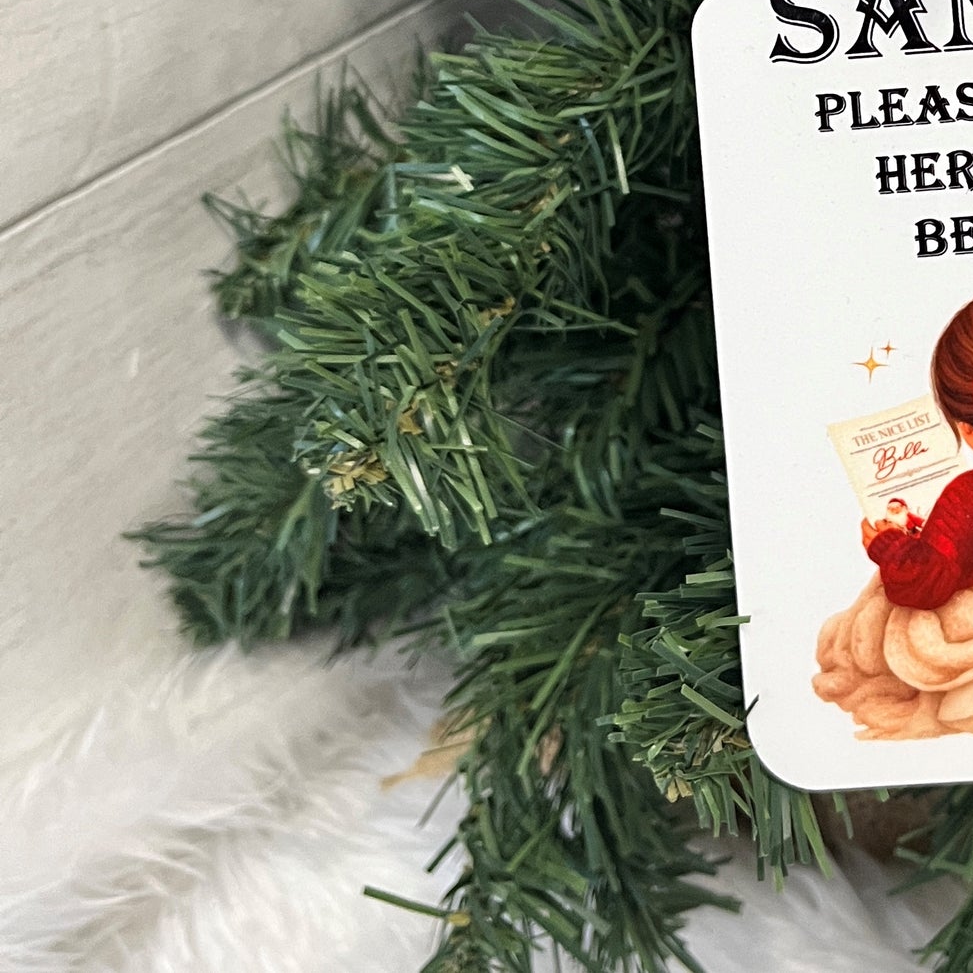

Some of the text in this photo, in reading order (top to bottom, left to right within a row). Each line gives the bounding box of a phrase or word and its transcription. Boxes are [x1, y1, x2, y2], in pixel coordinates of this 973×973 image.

[851, 412, 932, 447] THE NICE LIST
[872, 440, 930, 481] Bella
